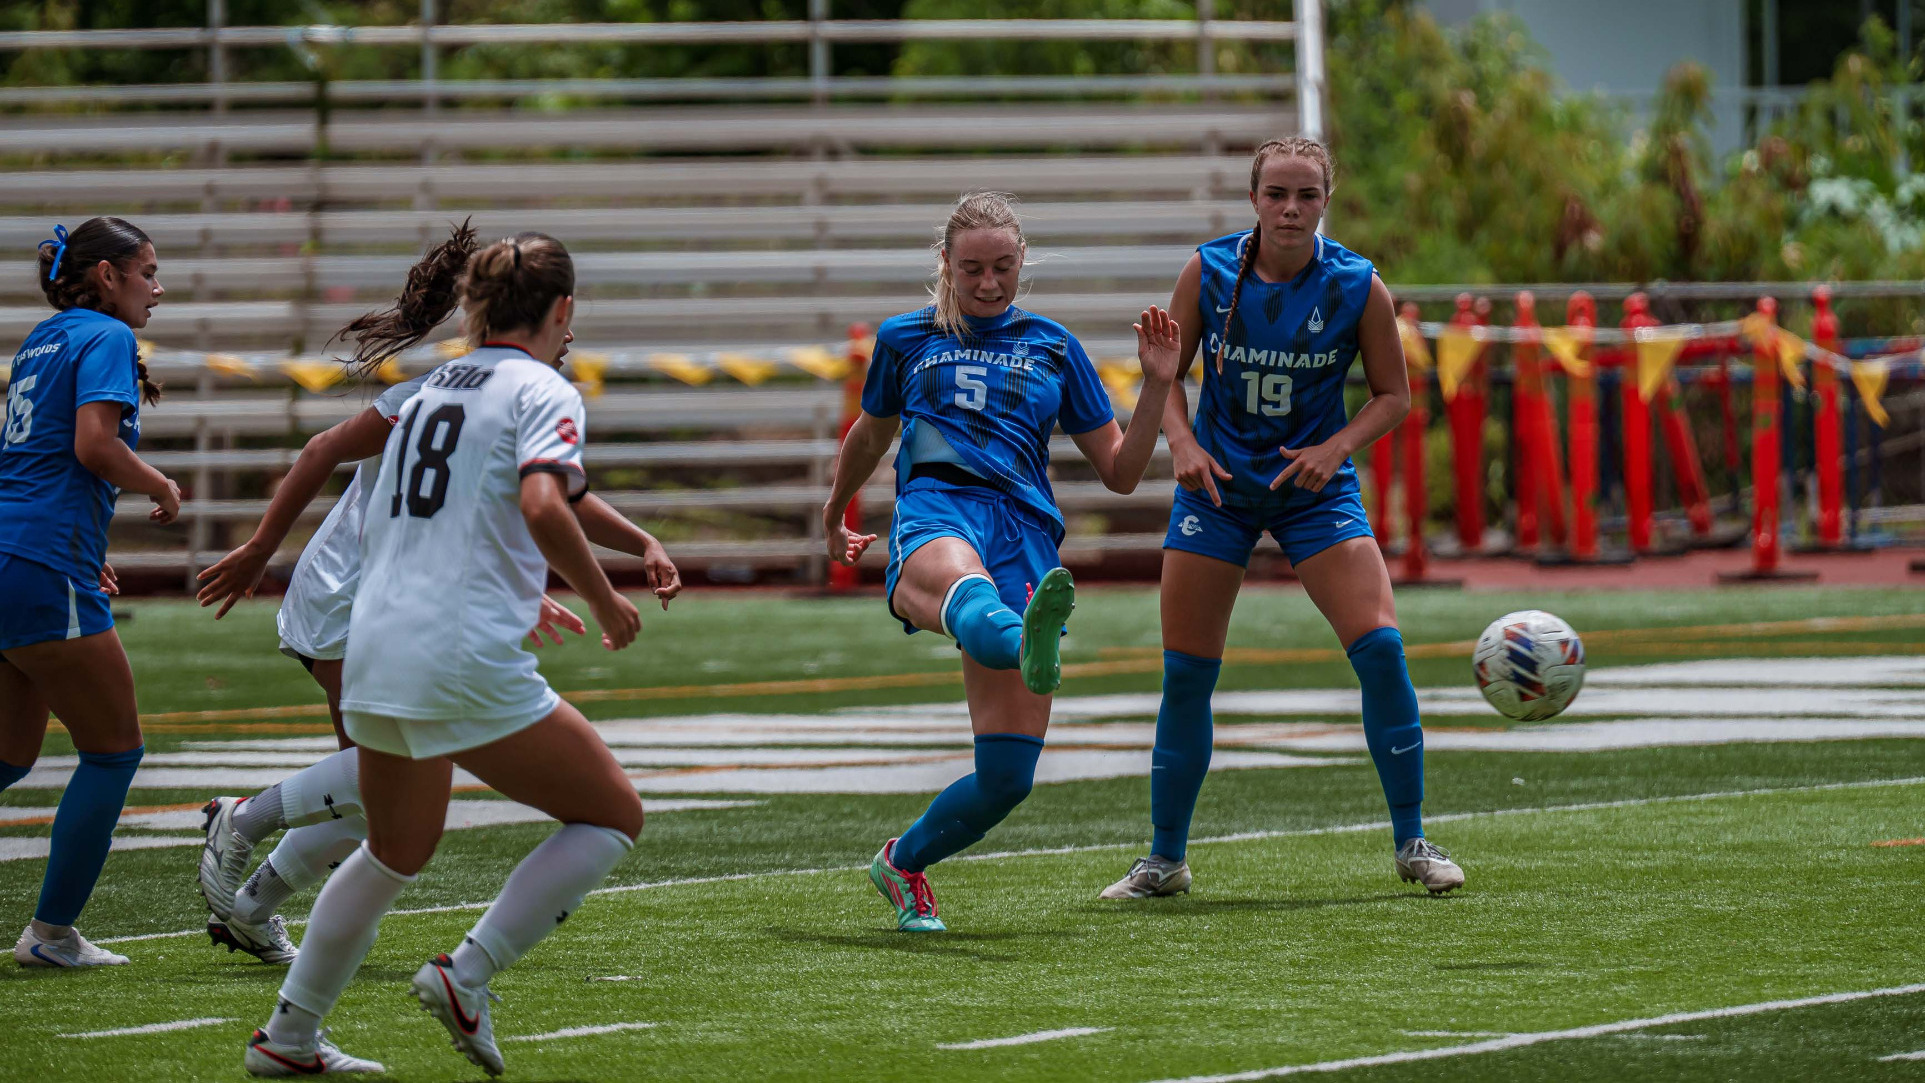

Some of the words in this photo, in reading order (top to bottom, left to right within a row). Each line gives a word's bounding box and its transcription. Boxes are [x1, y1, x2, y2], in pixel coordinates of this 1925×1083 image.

[954, 365, 988, 411] 5
[1240, 371, 1293, 417] 19
[390, 399, 466, 520] 18
